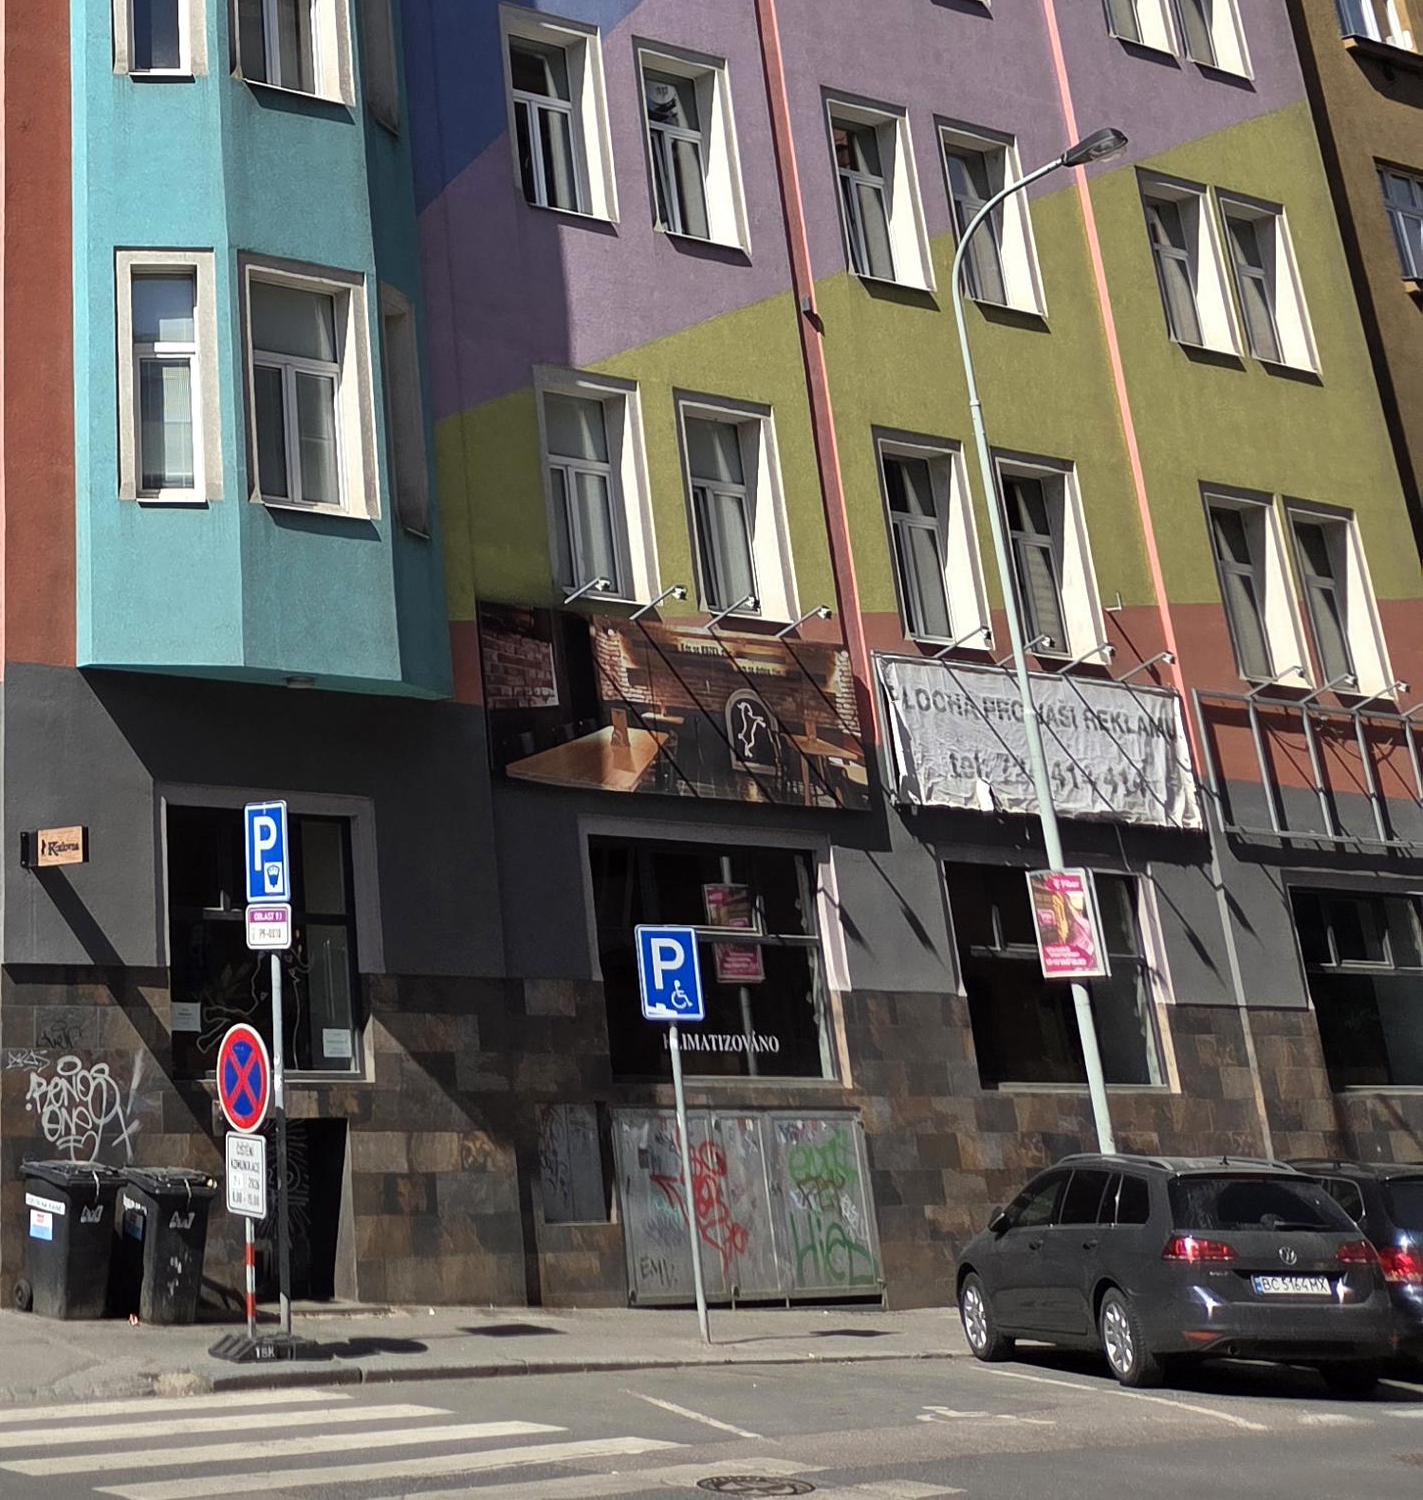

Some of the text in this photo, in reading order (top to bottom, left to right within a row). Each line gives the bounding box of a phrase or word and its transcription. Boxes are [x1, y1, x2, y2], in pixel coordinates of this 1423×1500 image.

[47, 840, 80, 857] Kozlovna
[650, 937, 685, 990] P
[662, 1029, 780, 1054] IMATIZOVÁNO
